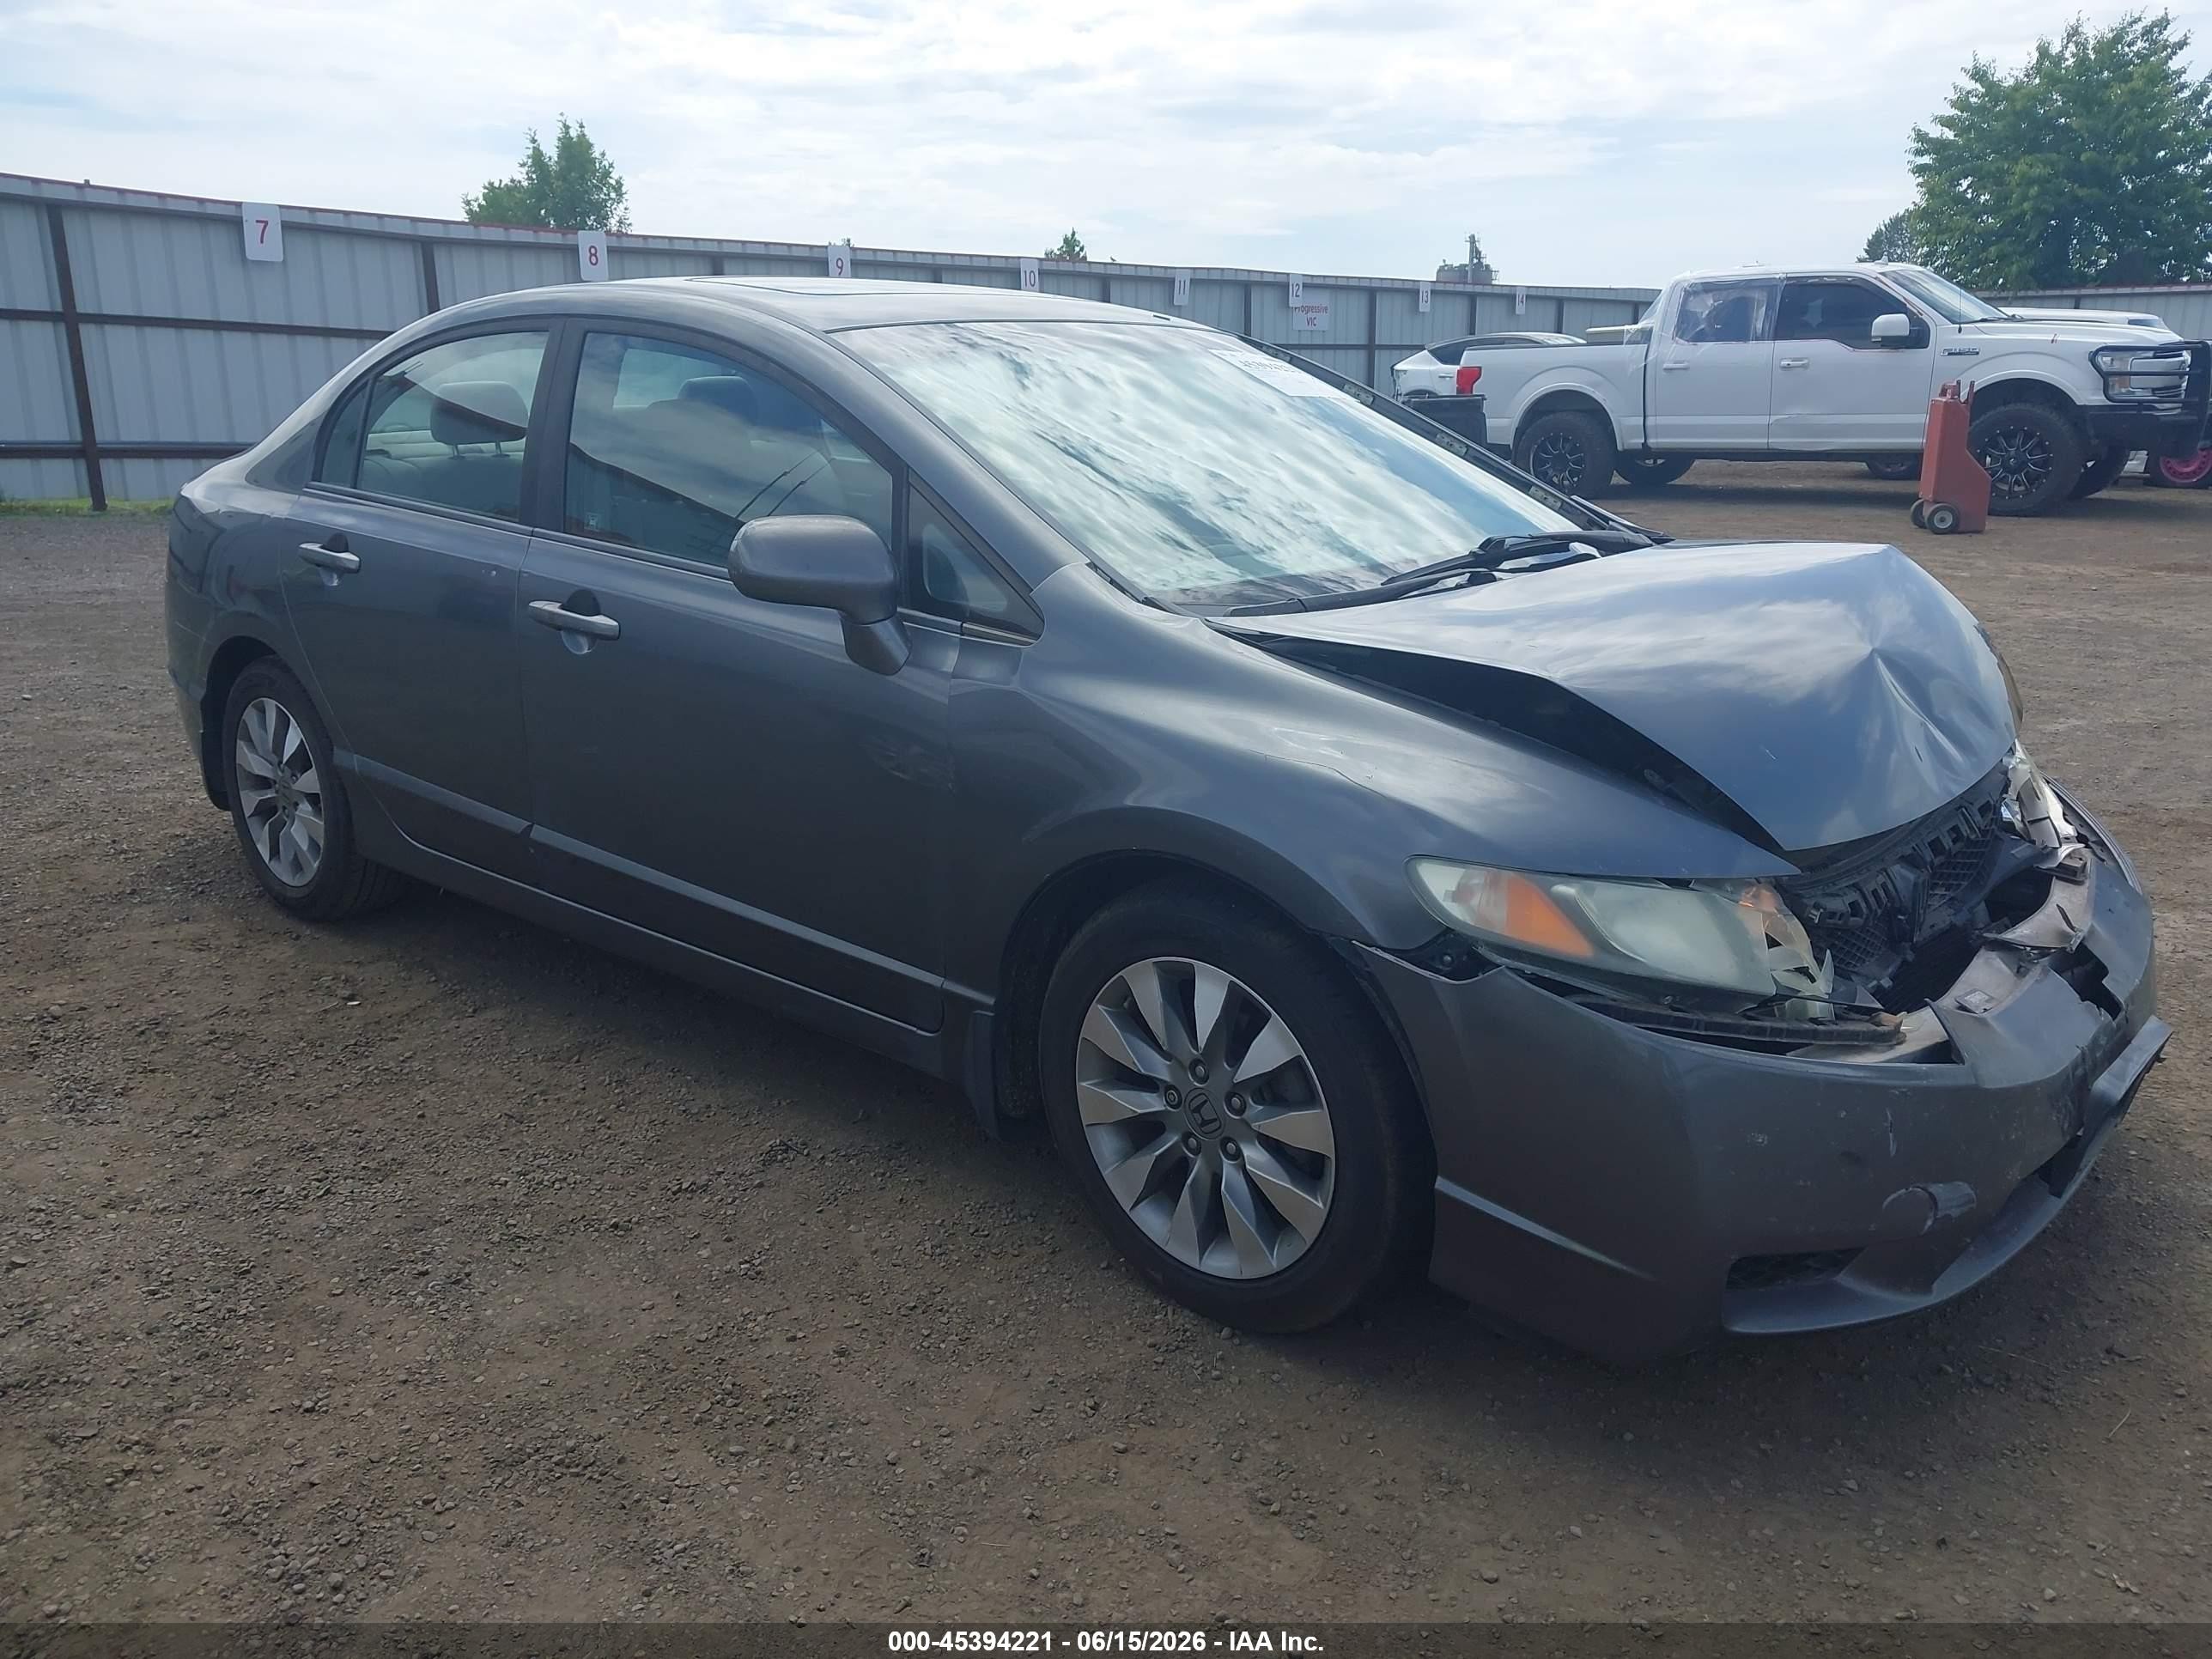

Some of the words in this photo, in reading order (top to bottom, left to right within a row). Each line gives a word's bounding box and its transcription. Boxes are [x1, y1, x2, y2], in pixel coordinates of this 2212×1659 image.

[255, 219, 269, 245] 7
[588, 245, 599, 266] 8
[836, 257, 844, 276] 9
[1024, 270, 1036, 288] 10
[1178, 279, 1187, 295] 11
[1291, 283, 1300, 298] 12
[1421, 290, 1429, 304] 13
[1306, 316, 1317, 327] VIC
